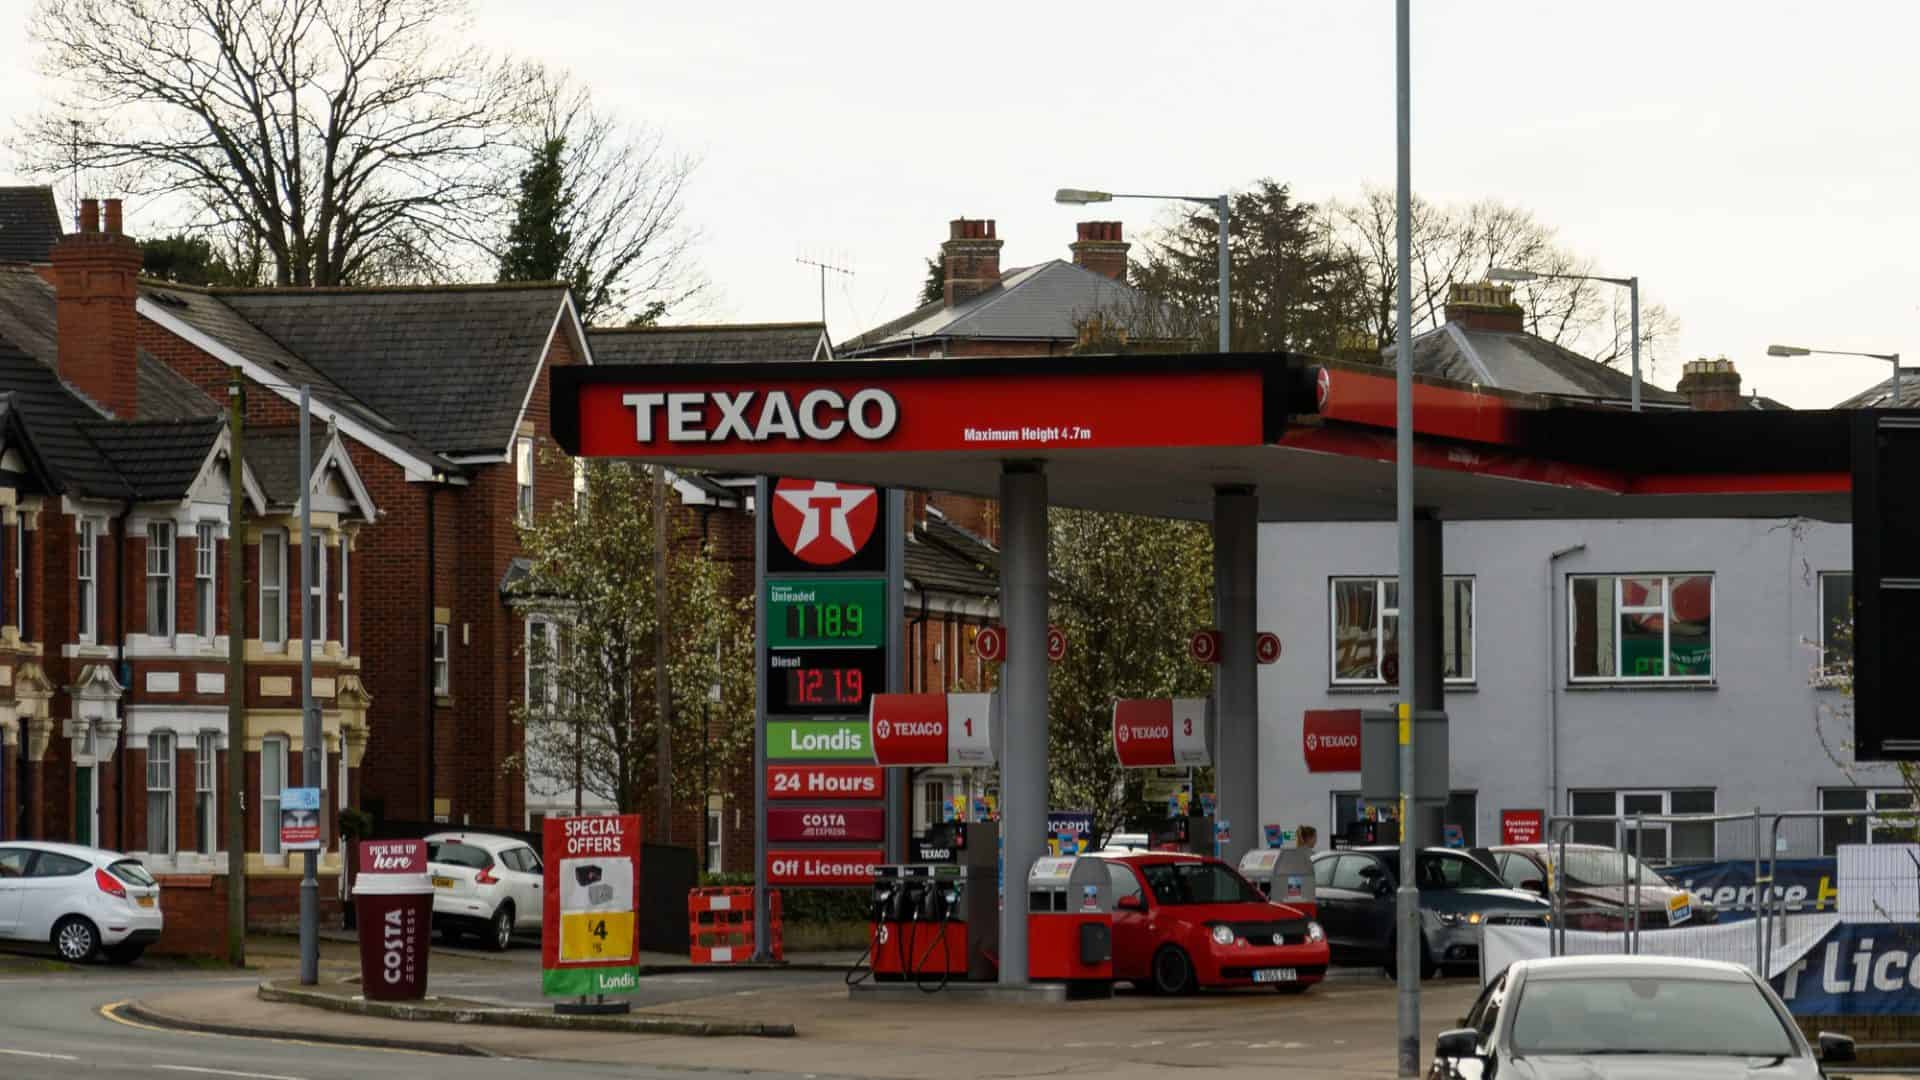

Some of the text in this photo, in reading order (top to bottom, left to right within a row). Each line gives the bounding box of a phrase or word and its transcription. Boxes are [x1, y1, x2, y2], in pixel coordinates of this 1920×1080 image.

[622, 388, 898, 443] TEXACO
[964, 426, 1092, 443] Maximum Height 4.7m
[771, 591, 816, 602] Unleaded
[797, 603, 863, 638] 118.9
[1050, 636, 1060, 652] 2
[1197, 637, 1208, 653] 3
[1262, 640, 1273, 656] 4
[771, 656, 801, 668] Diesel
[797, 669, 863, 703] 121.9
[893, 721, 943, 736] TEXACO
[963, 717, 973, 737] 1
[1131, 726, 1169, 740] TEXACO
[1183, 718, 1193, 736] 3
[790, 728, 862, 751] Londis
[1319, 735, 1358, 748] TEXACO
[773, 773, 876, 792] 24 Hours
[564, 819, 625, 837] SPECIAL
[802, 814, 847, 827] COSTA
[369, 844, 417, 856] PICK ME UP
[567, 837, 622, 854] OFFERS
[374, 853, 413, 870] here
[920, 849, 950, 860] TEXACO
[771, 859, 876, 876] Off Licence
[383, 908, 403, 985] COSTA
[599, 973, 636, 989] Londis
